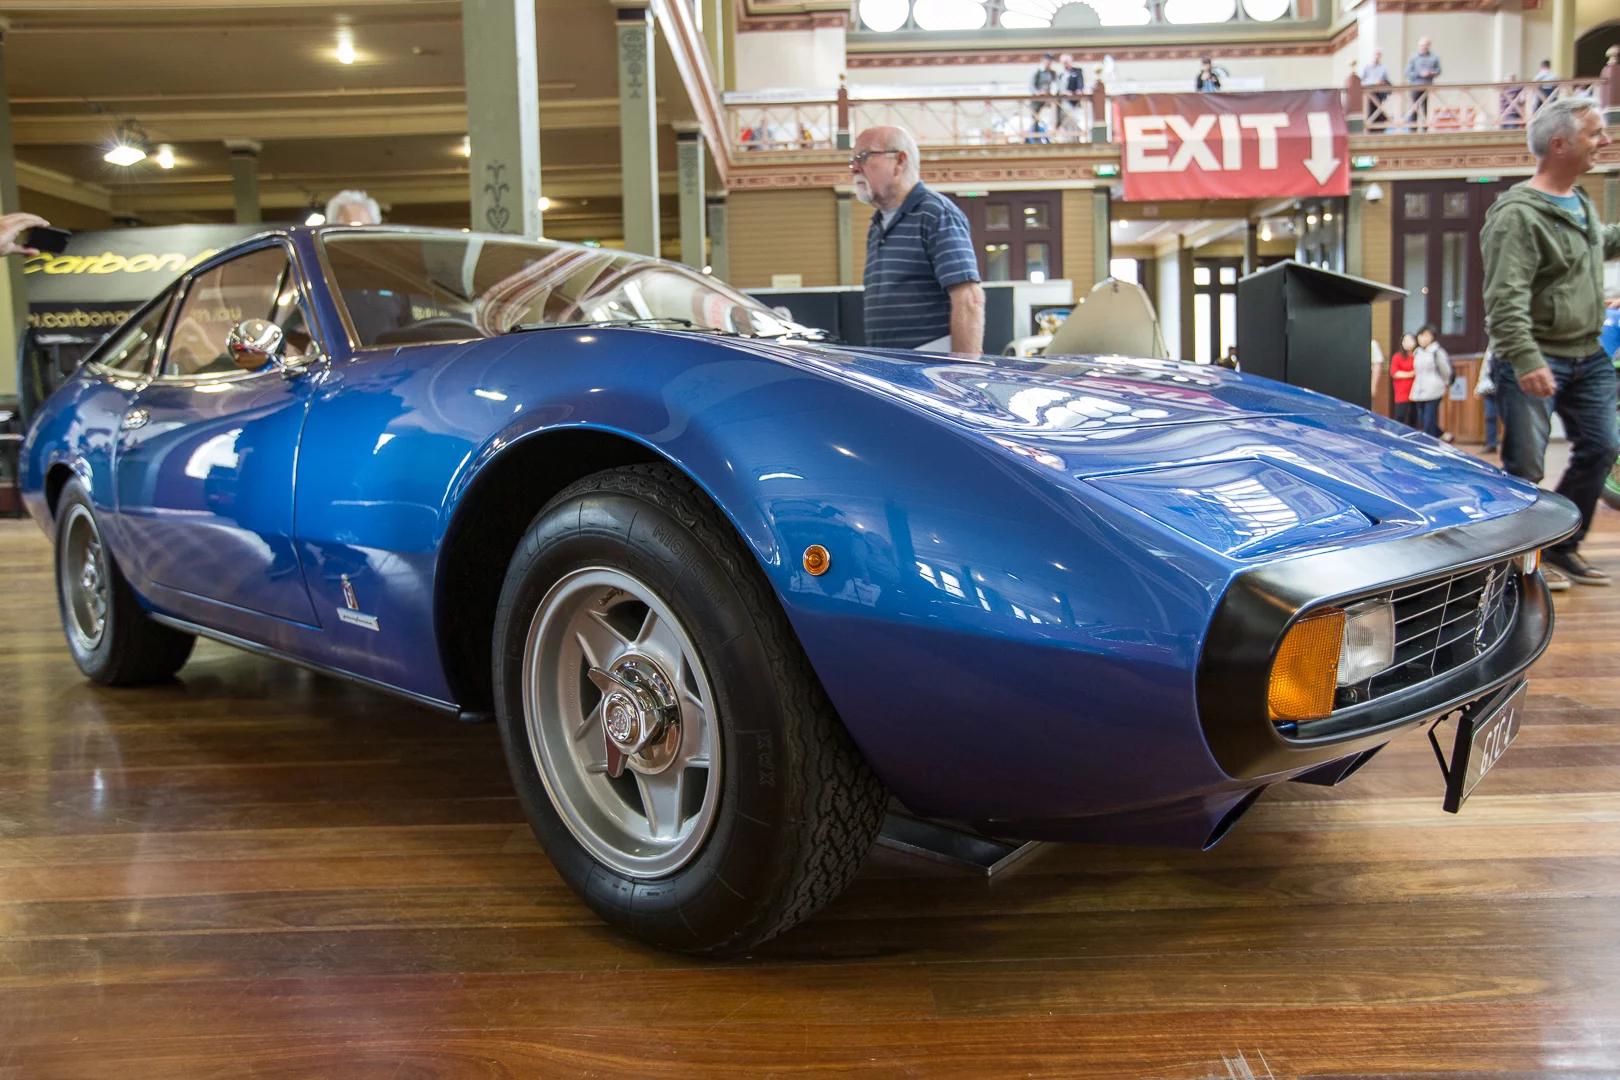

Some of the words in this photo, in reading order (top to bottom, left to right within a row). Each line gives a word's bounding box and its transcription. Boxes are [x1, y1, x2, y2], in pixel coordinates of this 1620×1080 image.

[1123, 113, 1290, 173] EXIT
[652, 523, 728, 610] MICHELIN
[755, 733, 776, 787] XWX
